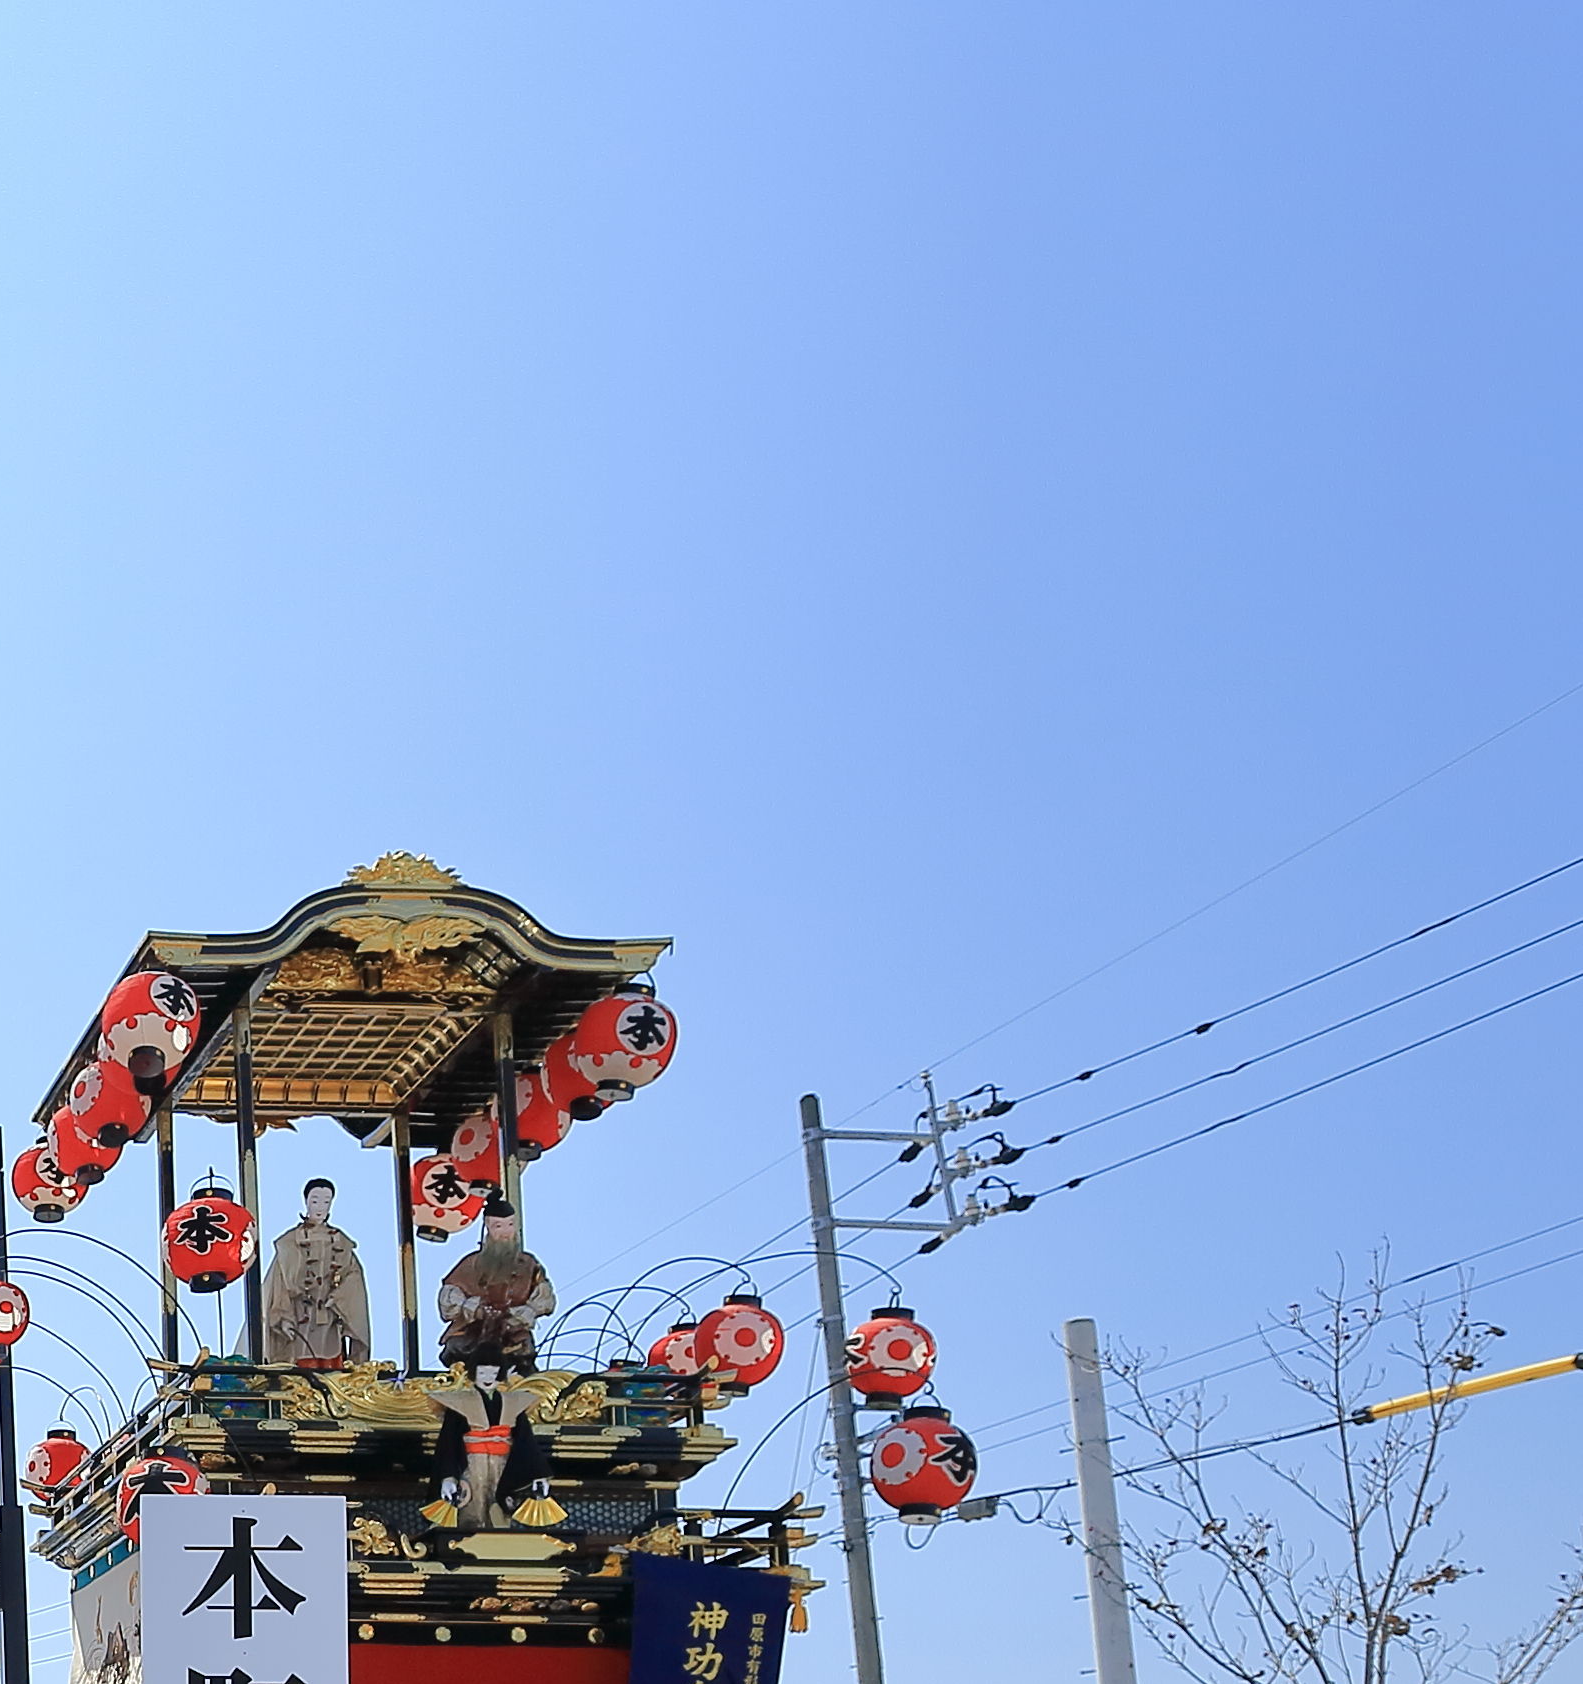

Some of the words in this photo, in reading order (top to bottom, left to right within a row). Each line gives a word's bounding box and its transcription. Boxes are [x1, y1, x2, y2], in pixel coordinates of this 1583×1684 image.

[154, 977, 195, 1016] 本
[620, 1005, 667, 1051] 本
[425, 1164, 467, 1204] 本
[176, 1206, 231, 1252] 本
